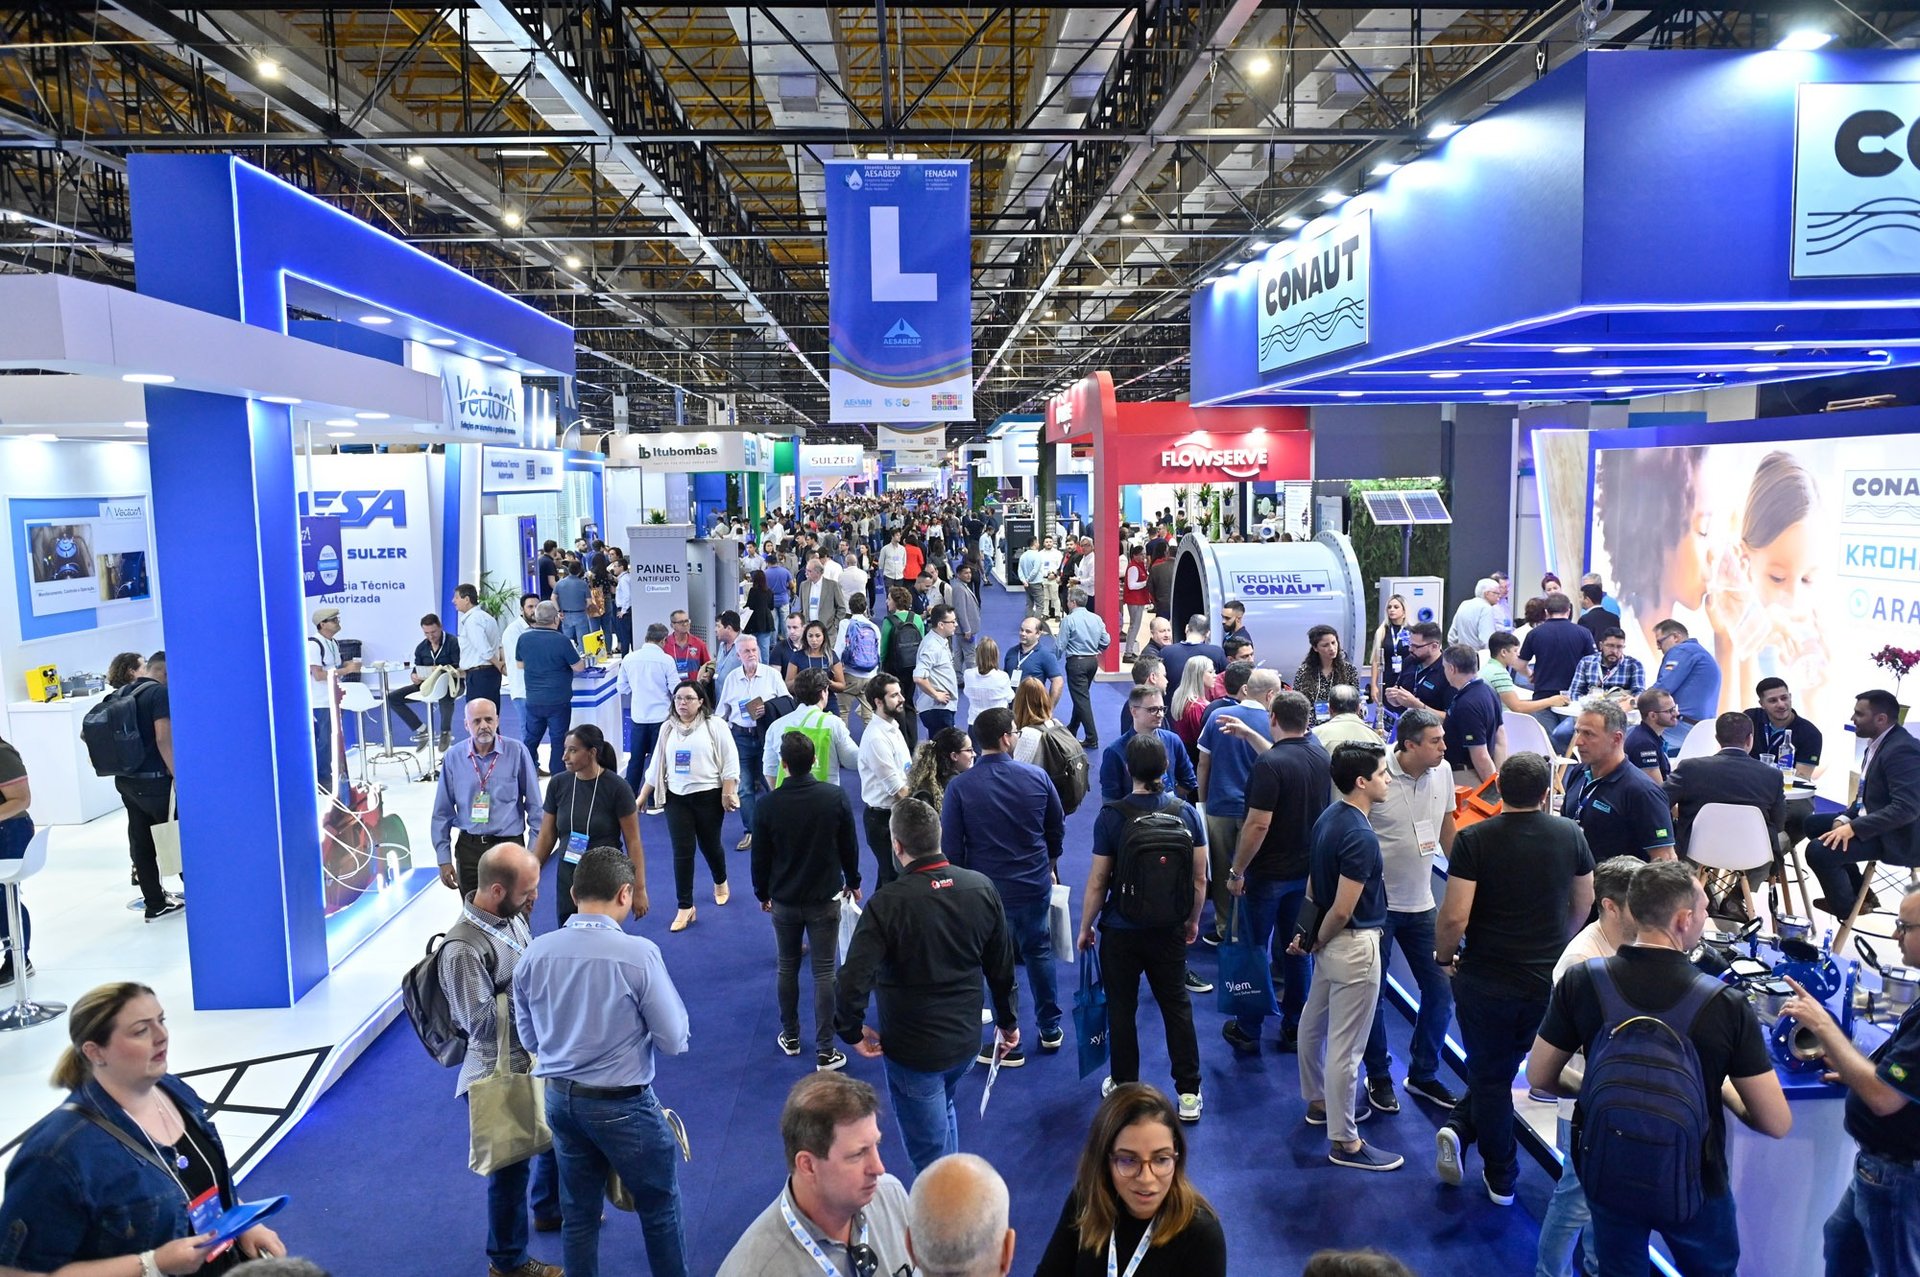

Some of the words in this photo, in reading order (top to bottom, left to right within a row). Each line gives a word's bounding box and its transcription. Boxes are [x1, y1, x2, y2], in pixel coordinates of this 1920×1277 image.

[1834, 109, 1920, 178] C
[870, 206, 937, 301] L
[1266, 234, 1359, 316] CONAUT
[456, 376, 516, 422] VectorA
[653, 446, 718, 457] Itubombas
[1162, 448, 1268, 466] FLOWSERVE
[812, 456, 854, 464] SULZER
[347, 548, 407, 559] SULZER
[1846, 544, 1920, 570] KROH
[637, 564, 680, 573] PAINEL
[1236, 574, 1302, 584] KROHNE
[360, 580, 405, 590] Técnica
[1243, 584, 1325, 595] CONAUT
[320, 594, 381, 603] Autorizada
